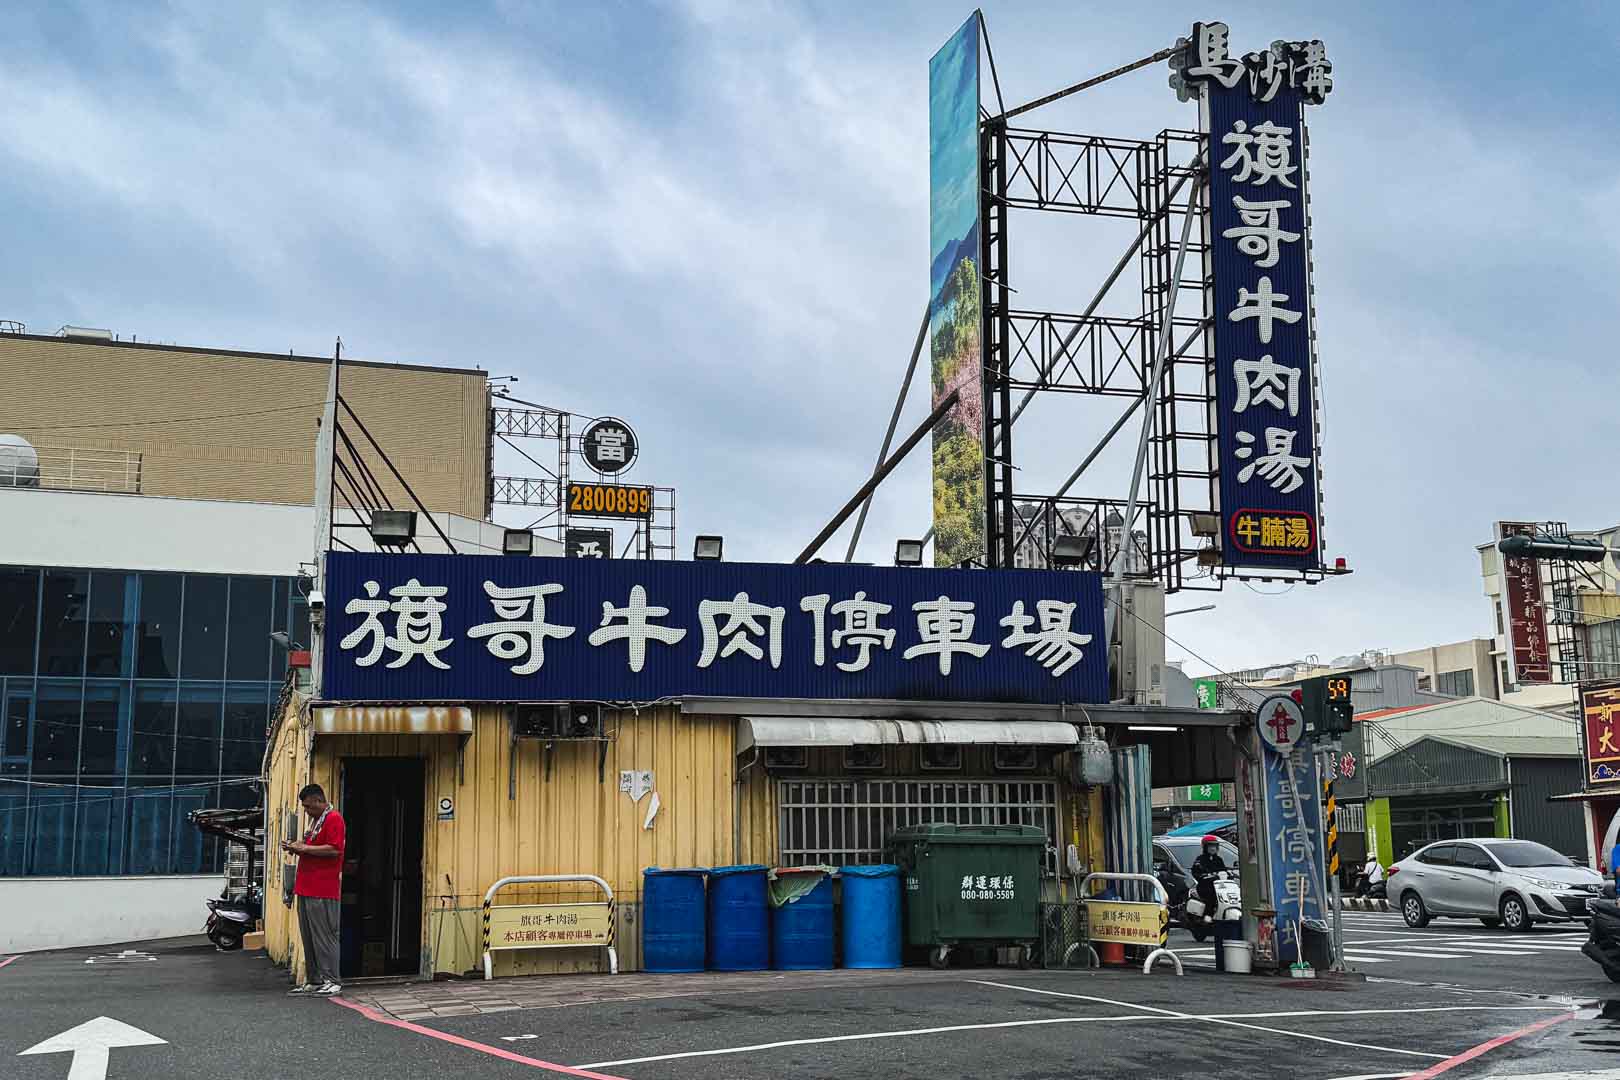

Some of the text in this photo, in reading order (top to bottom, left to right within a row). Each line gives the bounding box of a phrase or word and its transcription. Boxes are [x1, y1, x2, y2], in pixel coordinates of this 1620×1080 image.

[1189, 22, 1332, 101] 馬沙溝
[1220, 120, 1311, 493] 旗哥牛肉湯
[595, 428, 627, 462] 當
[571, 486, 649, 513] 2800899
[1237, 515, 1310, 548] 牛腩湯
[340, 578, 1092, 677] 旗哥牛肉停車場
[1327, 680, 1347, 700] 59
